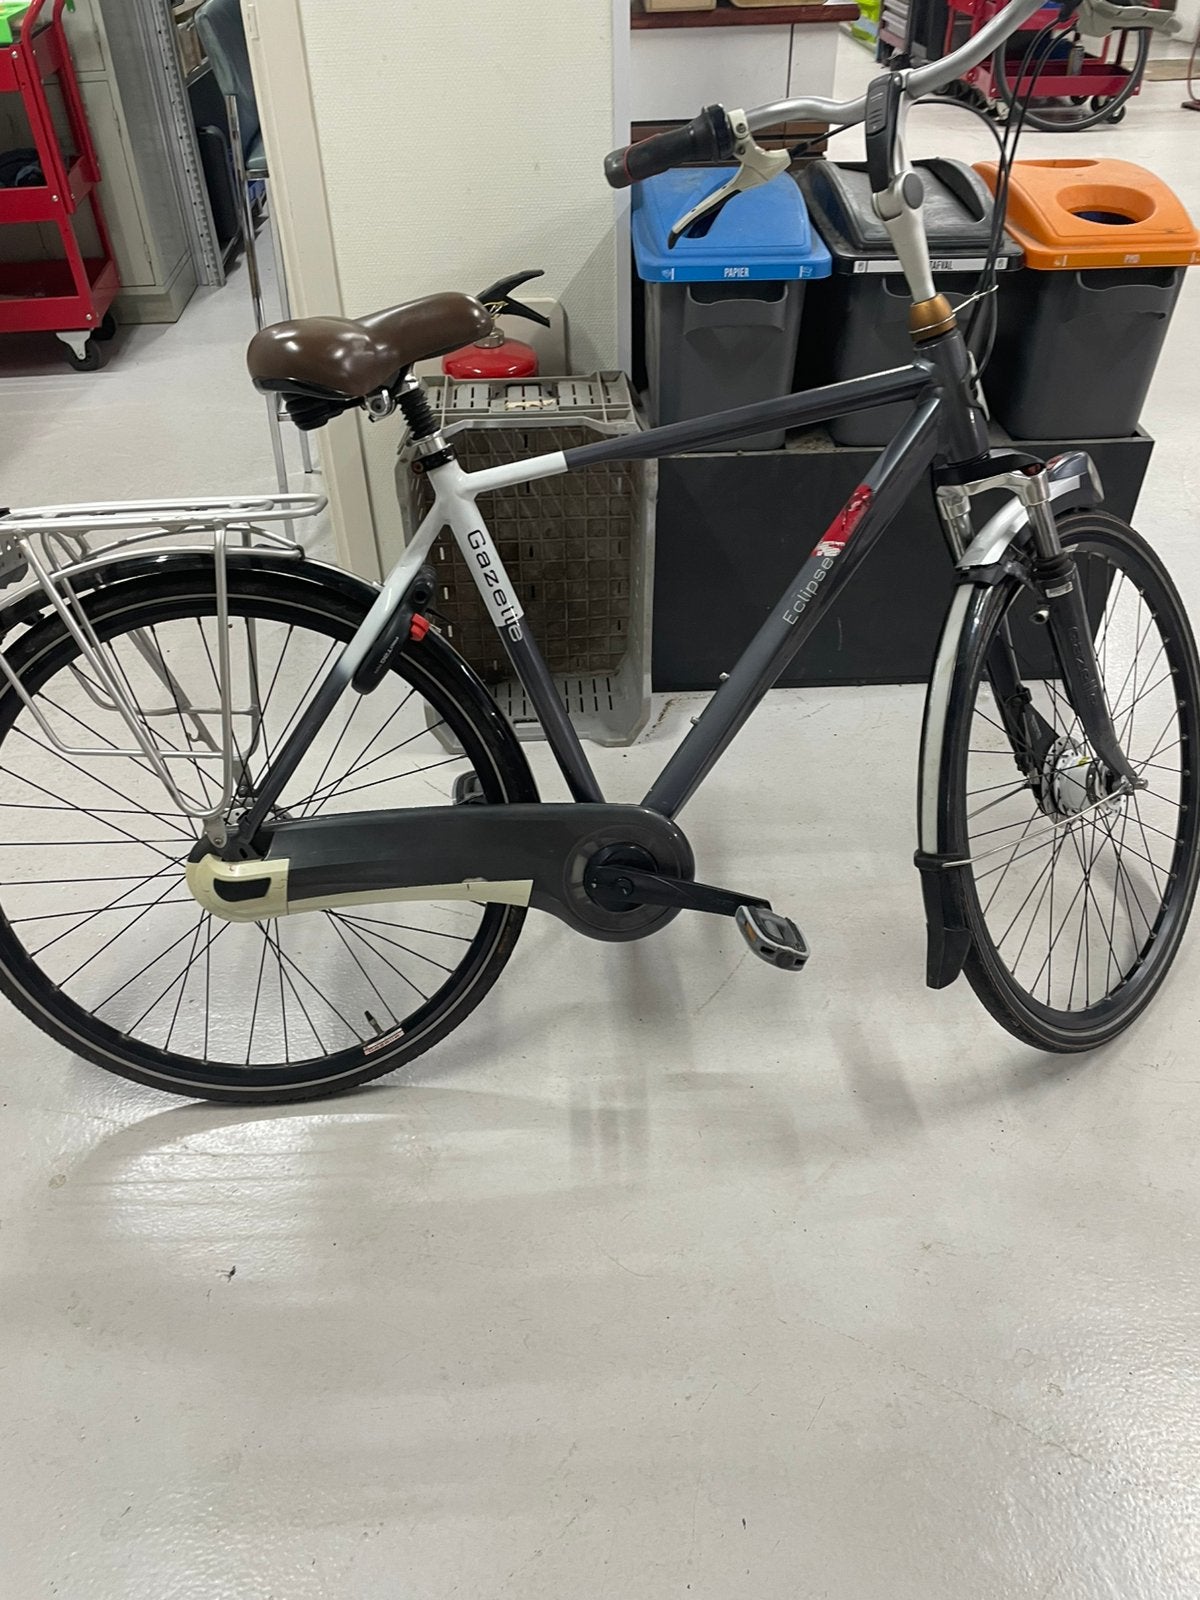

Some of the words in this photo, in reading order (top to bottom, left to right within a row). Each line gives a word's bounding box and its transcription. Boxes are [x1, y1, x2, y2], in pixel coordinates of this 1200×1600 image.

[723, 267, 750, 278] PAPIER
[929, 260, 954, 270] TAFVAL
[467, 529, 523, 642] Gazelle
[782, 557, 834, 625] Eclipse
